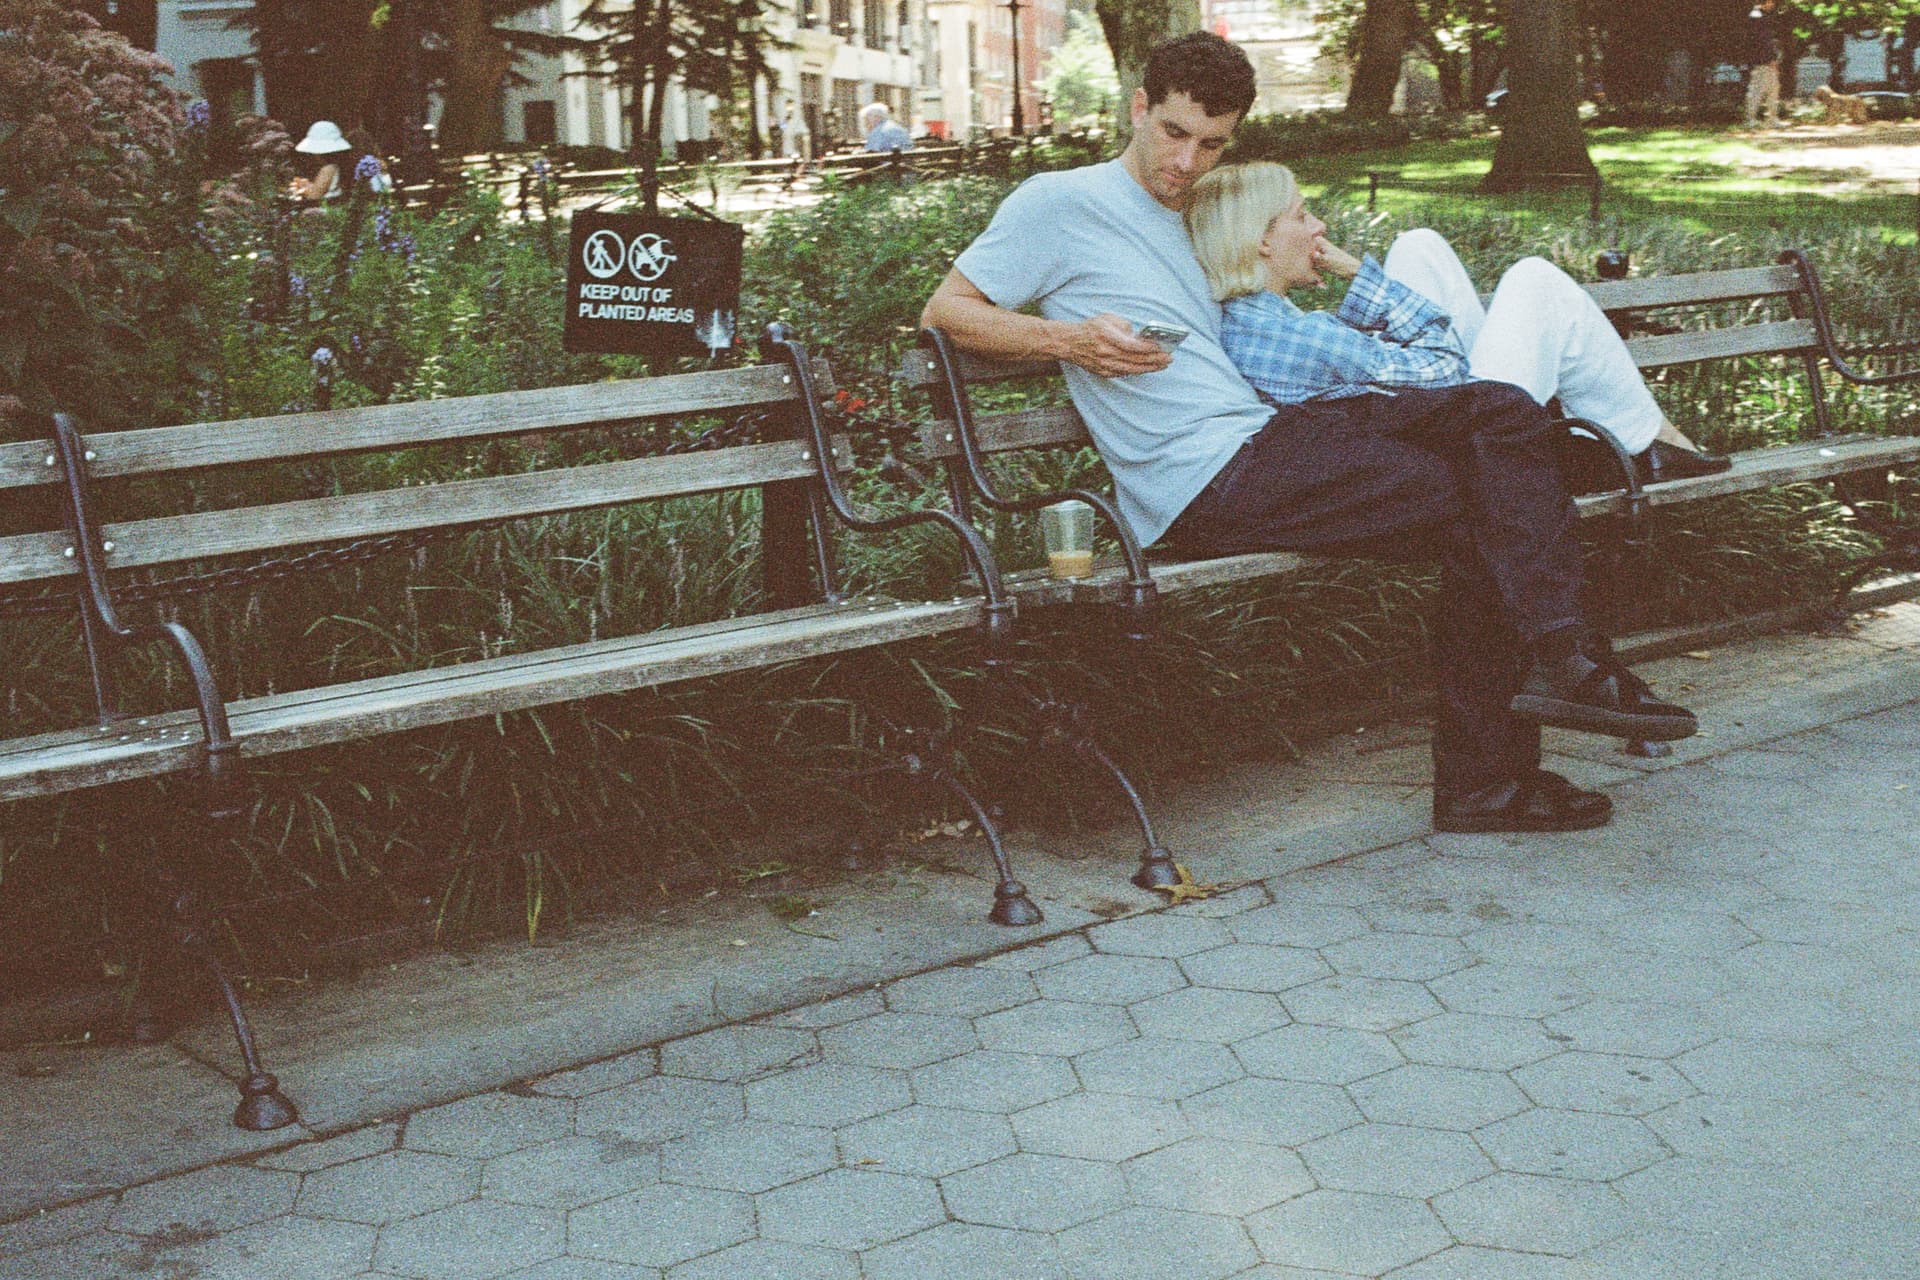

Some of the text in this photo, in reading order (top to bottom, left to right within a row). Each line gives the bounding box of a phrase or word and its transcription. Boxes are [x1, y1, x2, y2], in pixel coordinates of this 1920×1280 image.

[580, 283, 673, 303] KEEP OUT OF
[578, 303, 695, 323] PLANTED AREAS
